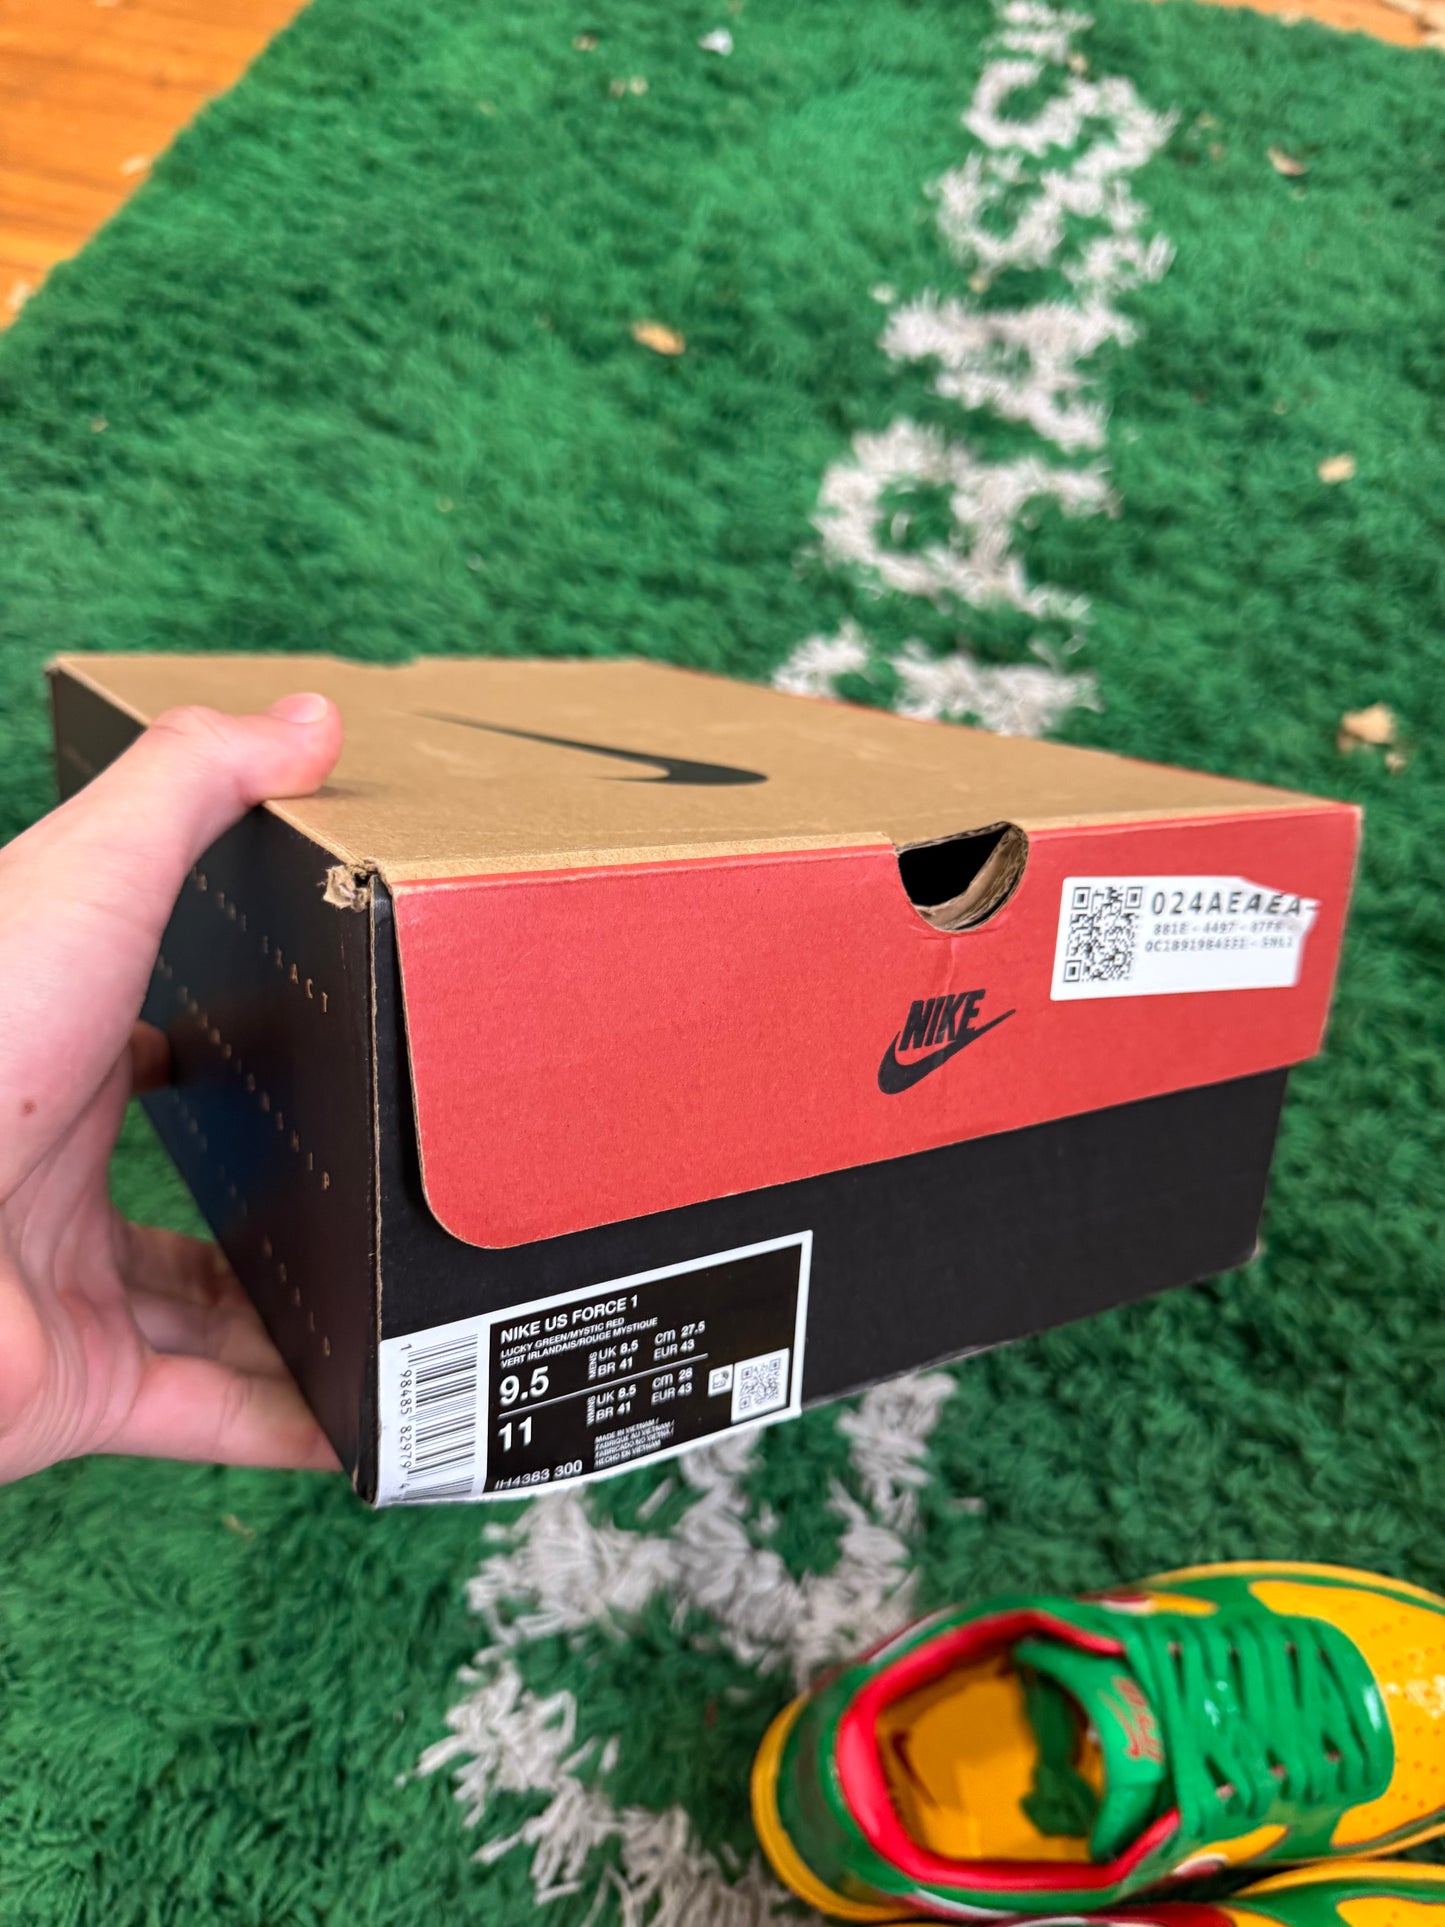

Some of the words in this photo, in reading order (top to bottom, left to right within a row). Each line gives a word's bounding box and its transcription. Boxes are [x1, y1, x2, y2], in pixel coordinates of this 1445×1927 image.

[260, 931, 330, 1015] EXACT
[898, 988, 987, 1051] NIKE
[500, 1320, 541, 1344] NIKE
[544, 1313, 568, 1332] US
[572, 1297, 627, 1325] FORCE
[630, 1294, 638, 1309] 1
[654, 1328, 676, 1345] cm
[681, 1321, 706, 1337] 27.5
[400, 1343, 413, 1351] 1
[500, 1342, 533, 1360] LUCKY
[534, 1322, 605, 1350] GREEN/MYSTIC
[605, 1317, 625, 1331] RED
[500, 1355, 526, 1370] VERT
[527, 1331, 612, 1362] IRLANDAIS/ROUGE
[612, 1317, 658, 1340] MYSTIQUE
[599, 1344, 617, 1361] UK
[620, 1339, 639, 1354] 8.5
[653, 1343, 678, 1361] EUR
[681, 1338, 695, 1353] 43
[588, 1351, 598, 1381] MENS
[598, 1361, 616, 1378] BR
[619, 1356, 633, 1371] 41
[652, 1373, 673, 1391] cm
[678, 1366, 693, 1383] 28
[400, 1369, 413, 1416] 98485
[499, 1366, 550, 1407] 9.5
[597, 1390, 615, 1407] UK
[618, 1384, 637, 1400] 8.5
[651, 1388, 676, 1406] EUR
[677, 1382, 692, 1397] 43
[595, 1406, 614, 1423] BR
[617, 1401, 631, 1416] 41
[400, 1424, 413, 1469] 82979
[498, 1416, 532, 1453] 11
[493, 1468, 550, 1491] IH4383
[554, 1459, 583, 1479] 300
